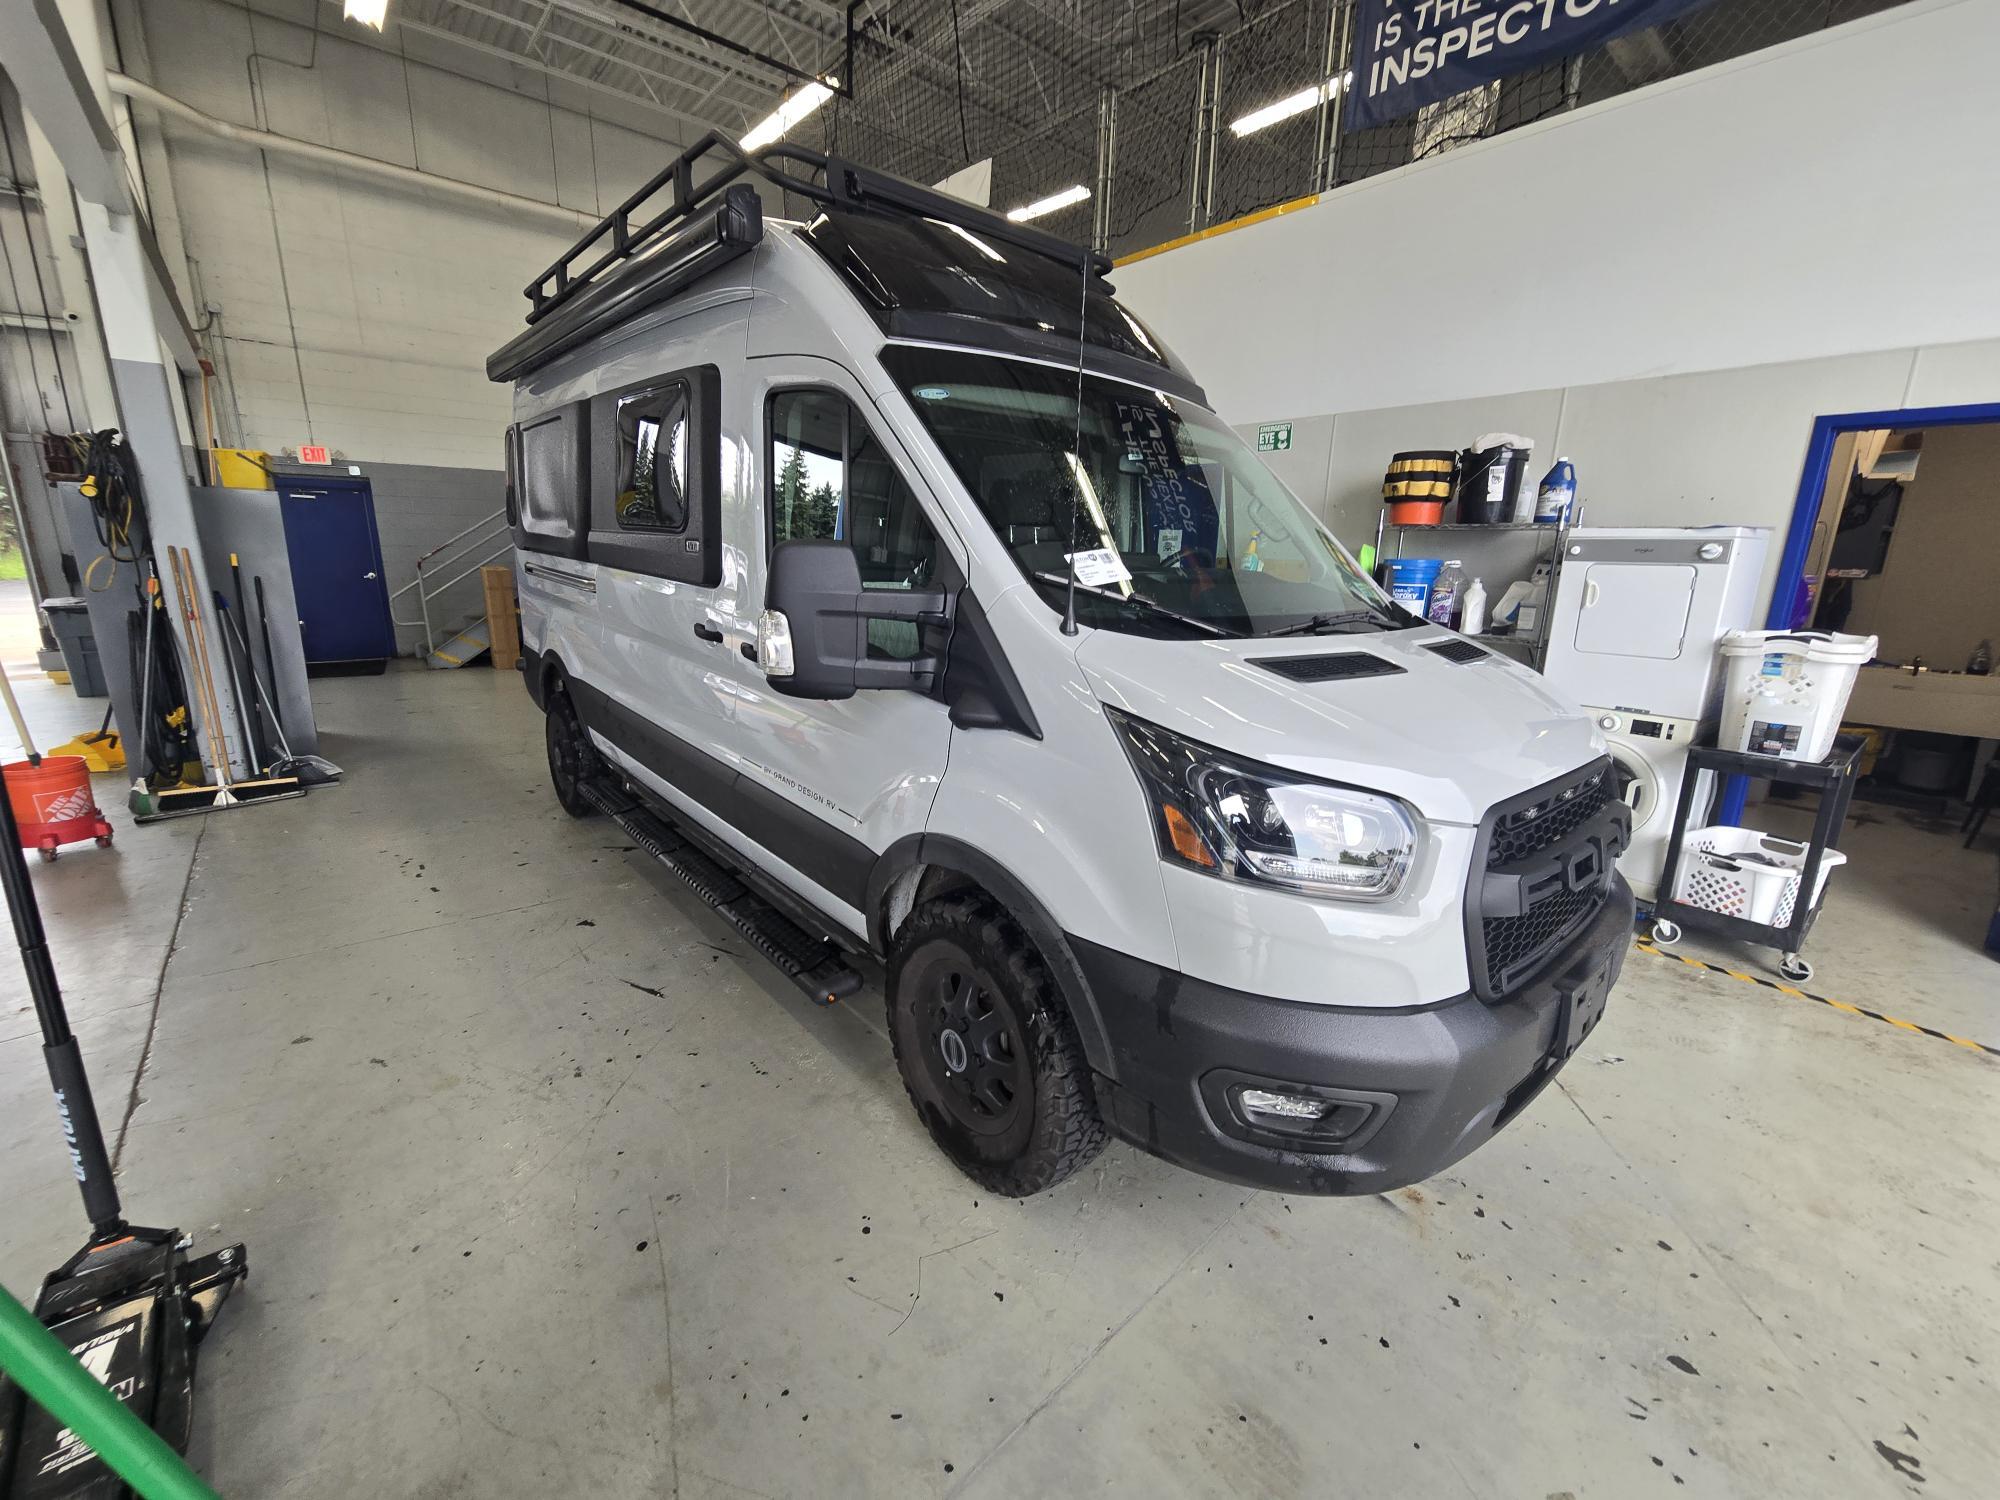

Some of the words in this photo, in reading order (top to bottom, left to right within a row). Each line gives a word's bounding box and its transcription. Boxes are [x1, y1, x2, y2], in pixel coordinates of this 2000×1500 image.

[1368, 0, 1619, 98] INSPECTO
[1374, 12, 1402, 53] IS
[302, 447, 326, 464] EXIT
[1260, 432, 1275, 445] EYE
[773, 771, 796, 788] GRAND
[797, 784, 825, 804] DESIGN
[825, 799, 836, 810] RV
